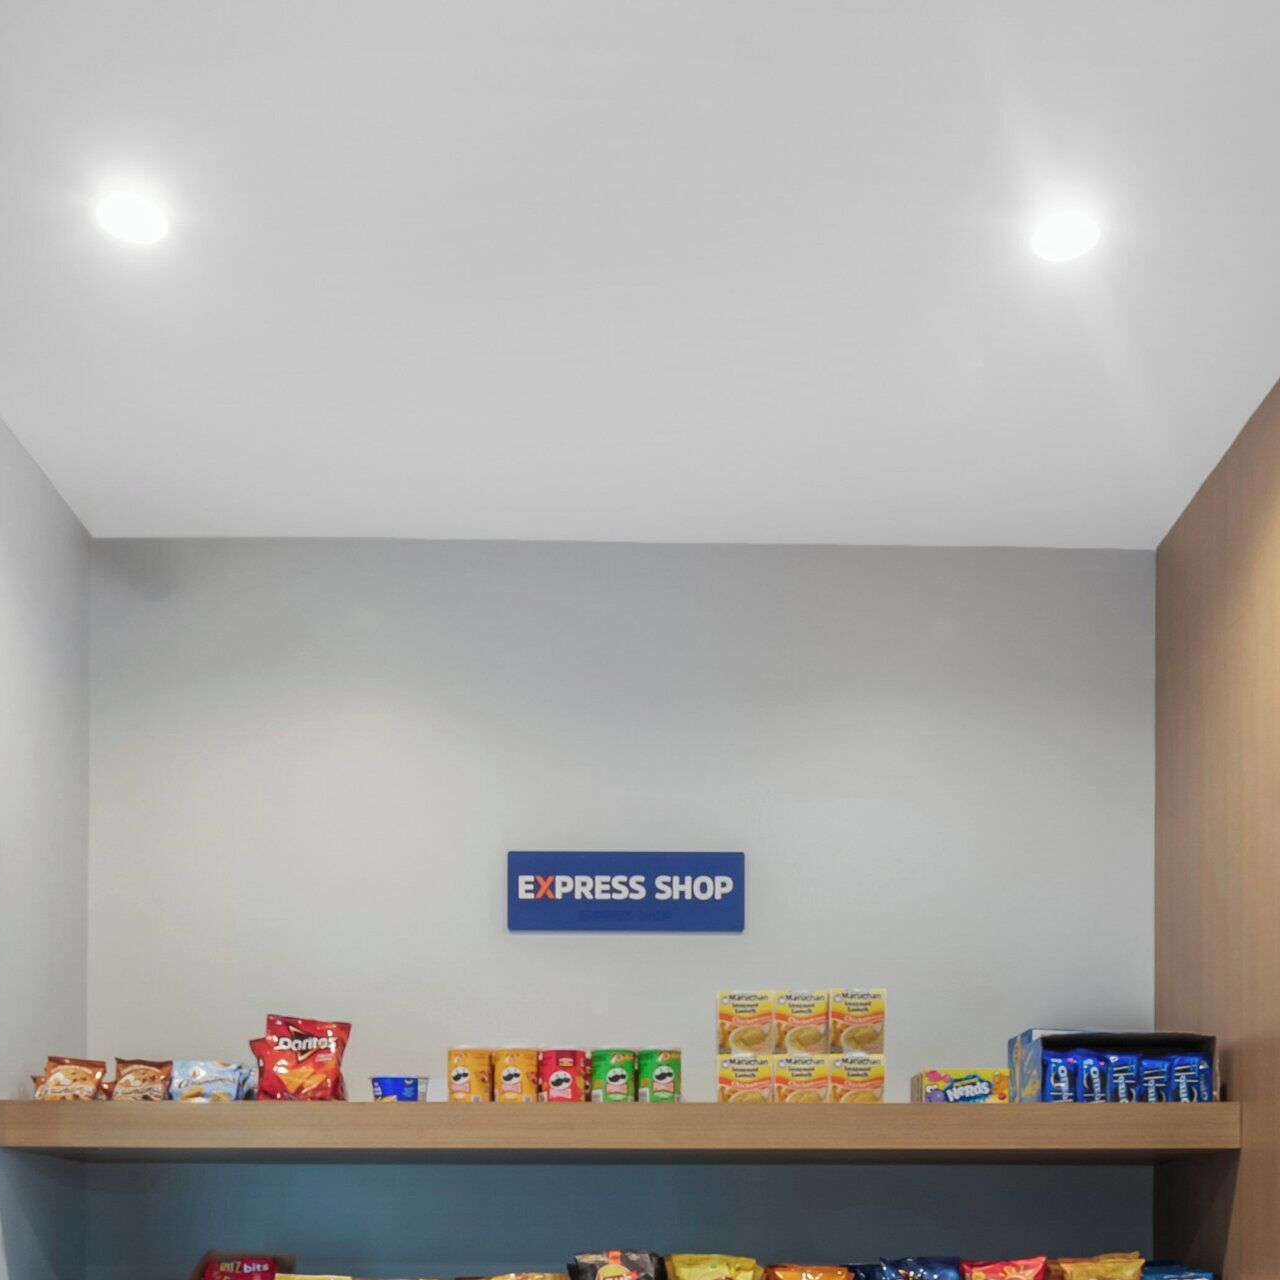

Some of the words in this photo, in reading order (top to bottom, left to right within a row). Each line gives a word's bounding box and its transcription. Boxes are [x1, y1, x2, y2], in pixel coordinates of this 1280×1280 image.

[518, 875, 647, 900] EXPRESS
[654, 875, 734, 900] SHOP
[243, 1263, 269, 1273] bits
